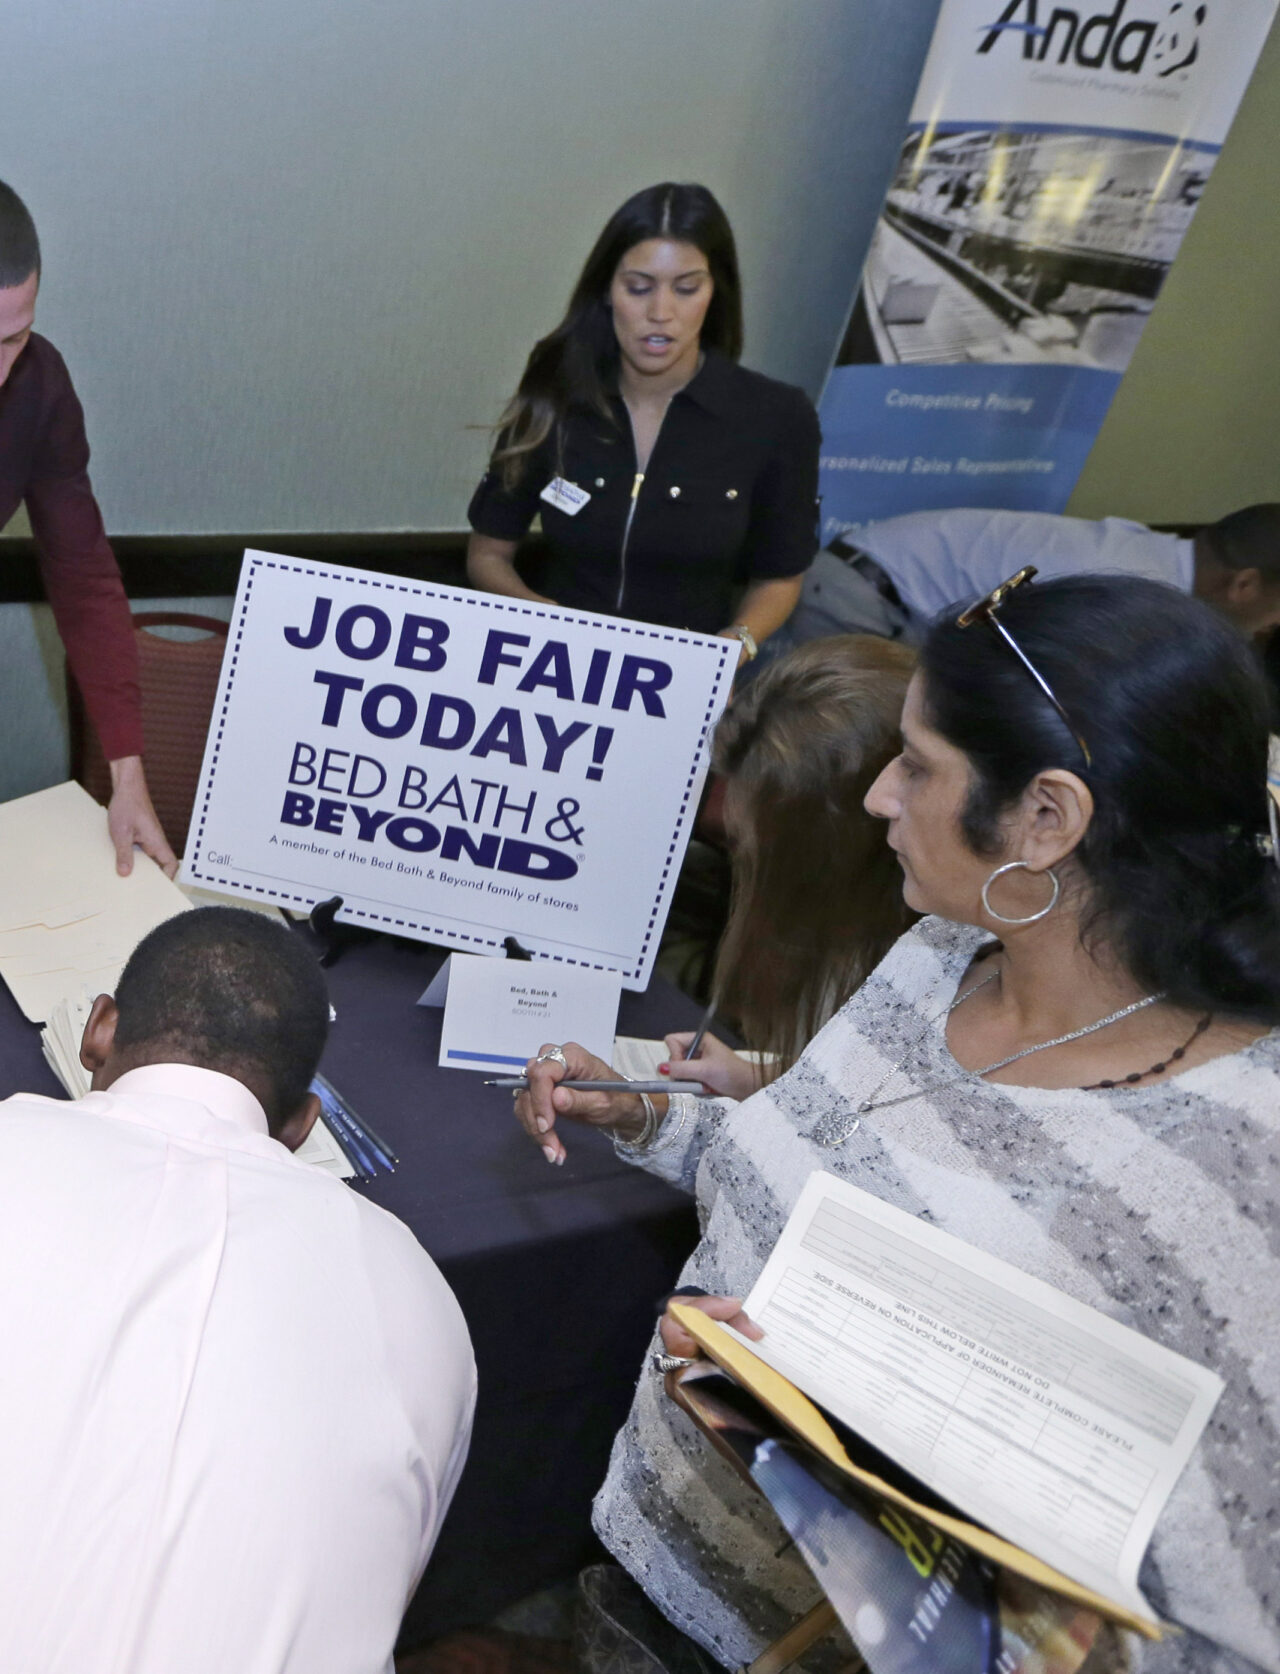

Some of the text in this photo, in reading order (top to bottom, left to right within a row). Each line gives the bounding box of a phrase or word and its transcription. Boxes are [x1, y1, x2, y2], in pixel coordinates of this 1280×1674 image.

[910, 456, 951, 474] Sales
[284, 597, 673, 719] JOB FAIR
[313, 670, 614, 782] TODAY!
[288, 741, 586, 847] BED BATH &
[280, 790, 579, 882] BEYOND
[207, 850, 233, 868] Call:
[269, 835, 580, 912] A member of the Bed Bath & Beyond family of stores
[833, 1281, 877, 1310] REVERSE
[876, 1305, 893, 1319] ON
[892, 1314, 956, 1353] APPLICATION
[893, 1300, 1050, 1390] DO NOT WRITE BELOW THIS LINE
[956, 1349, 971, 1362] OF
[970, 1357, 1031, 1394] REMAINDER
[1030, 1390, 1090, 1427] COMPLETE
[1089, 1422, 1135, 1451] PLEASE
